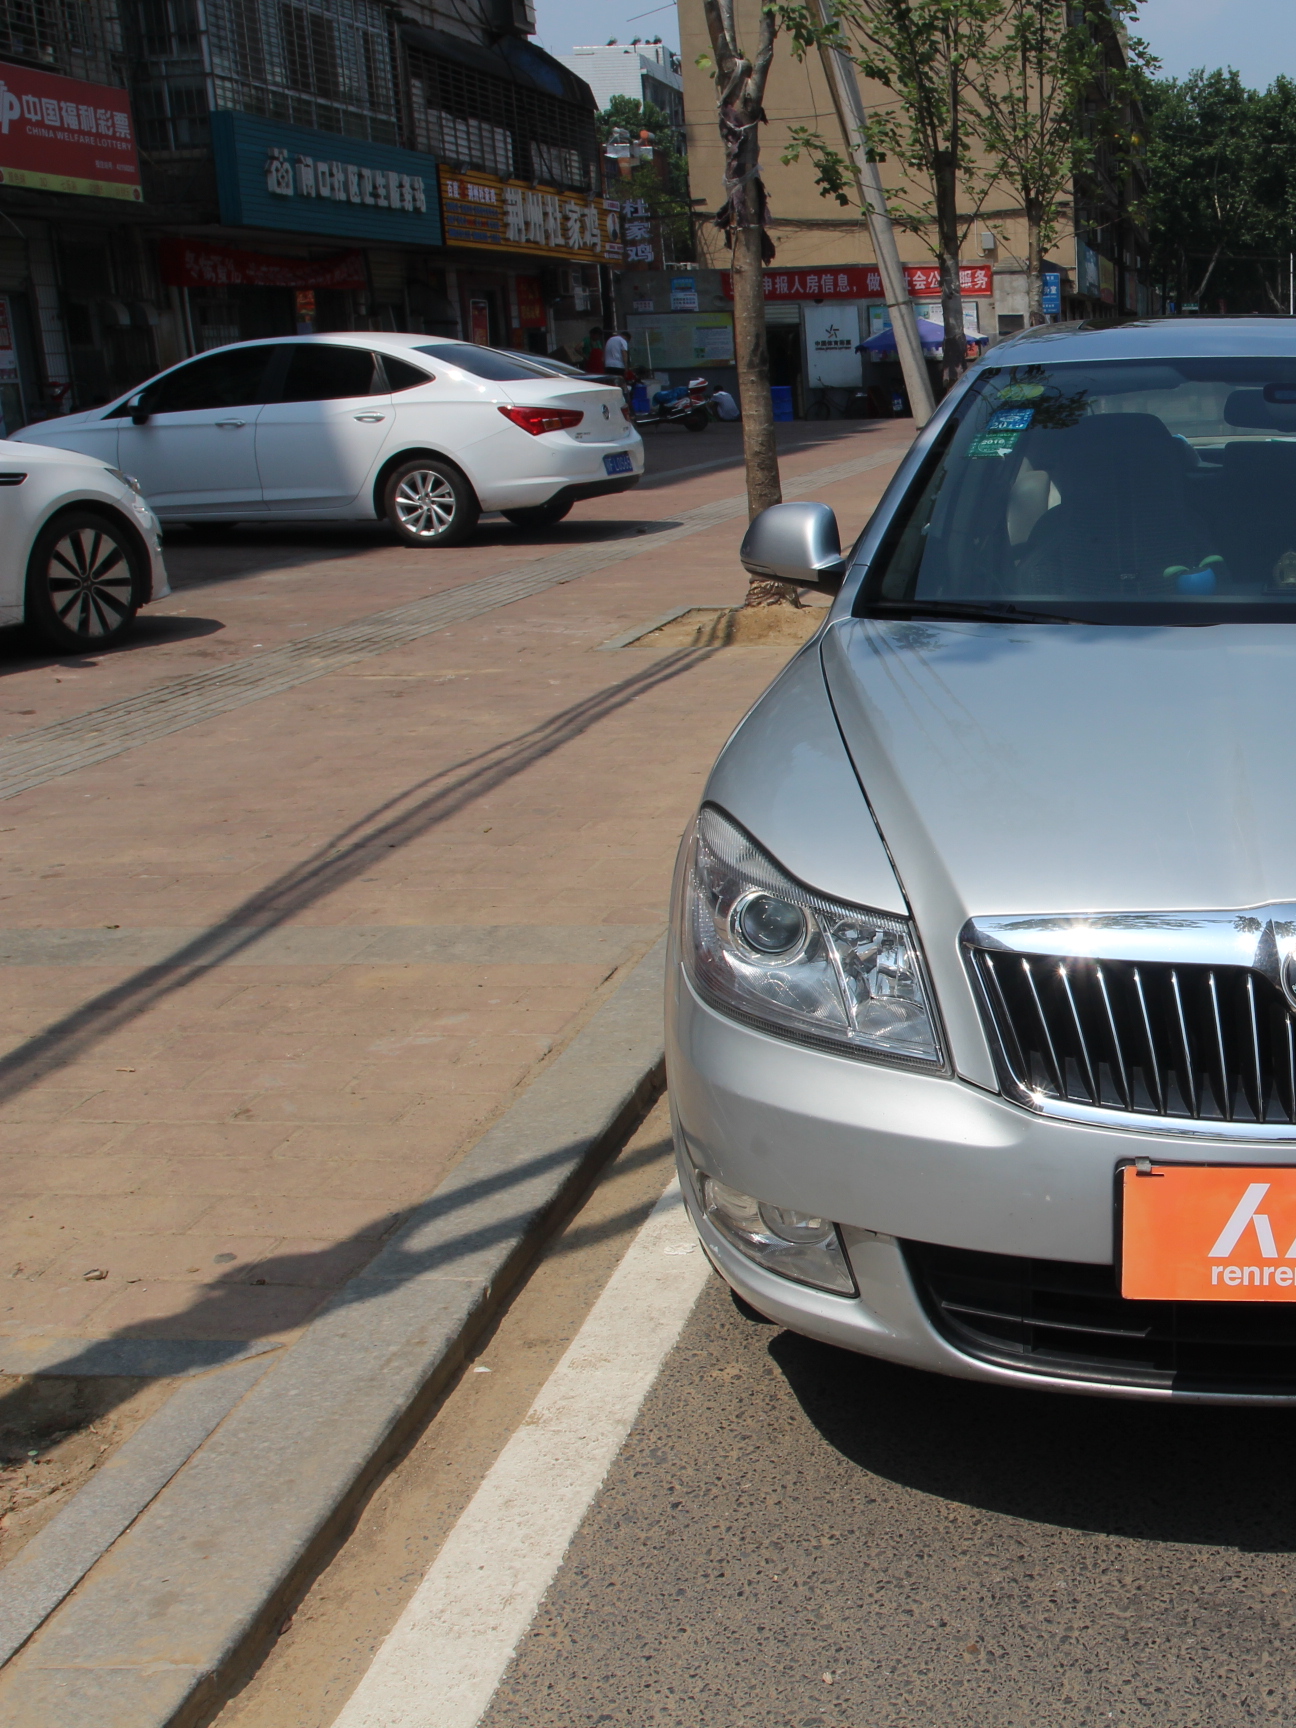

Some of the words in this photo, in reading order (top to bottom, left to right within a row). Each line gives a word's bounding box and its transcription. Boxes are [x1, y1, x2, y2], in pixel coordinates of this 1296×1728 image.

[21, 94, 131, 139] 中国福利彩票
[26, 125, 55, 138] CHINA
[56, 130, 96, 146] WELFARE
[97, 138, 132, 151] LOTTERY
[502, 187, 601, 253] 荆州杜家鸡
[622, 198, 654, 262] 杜家鸡
